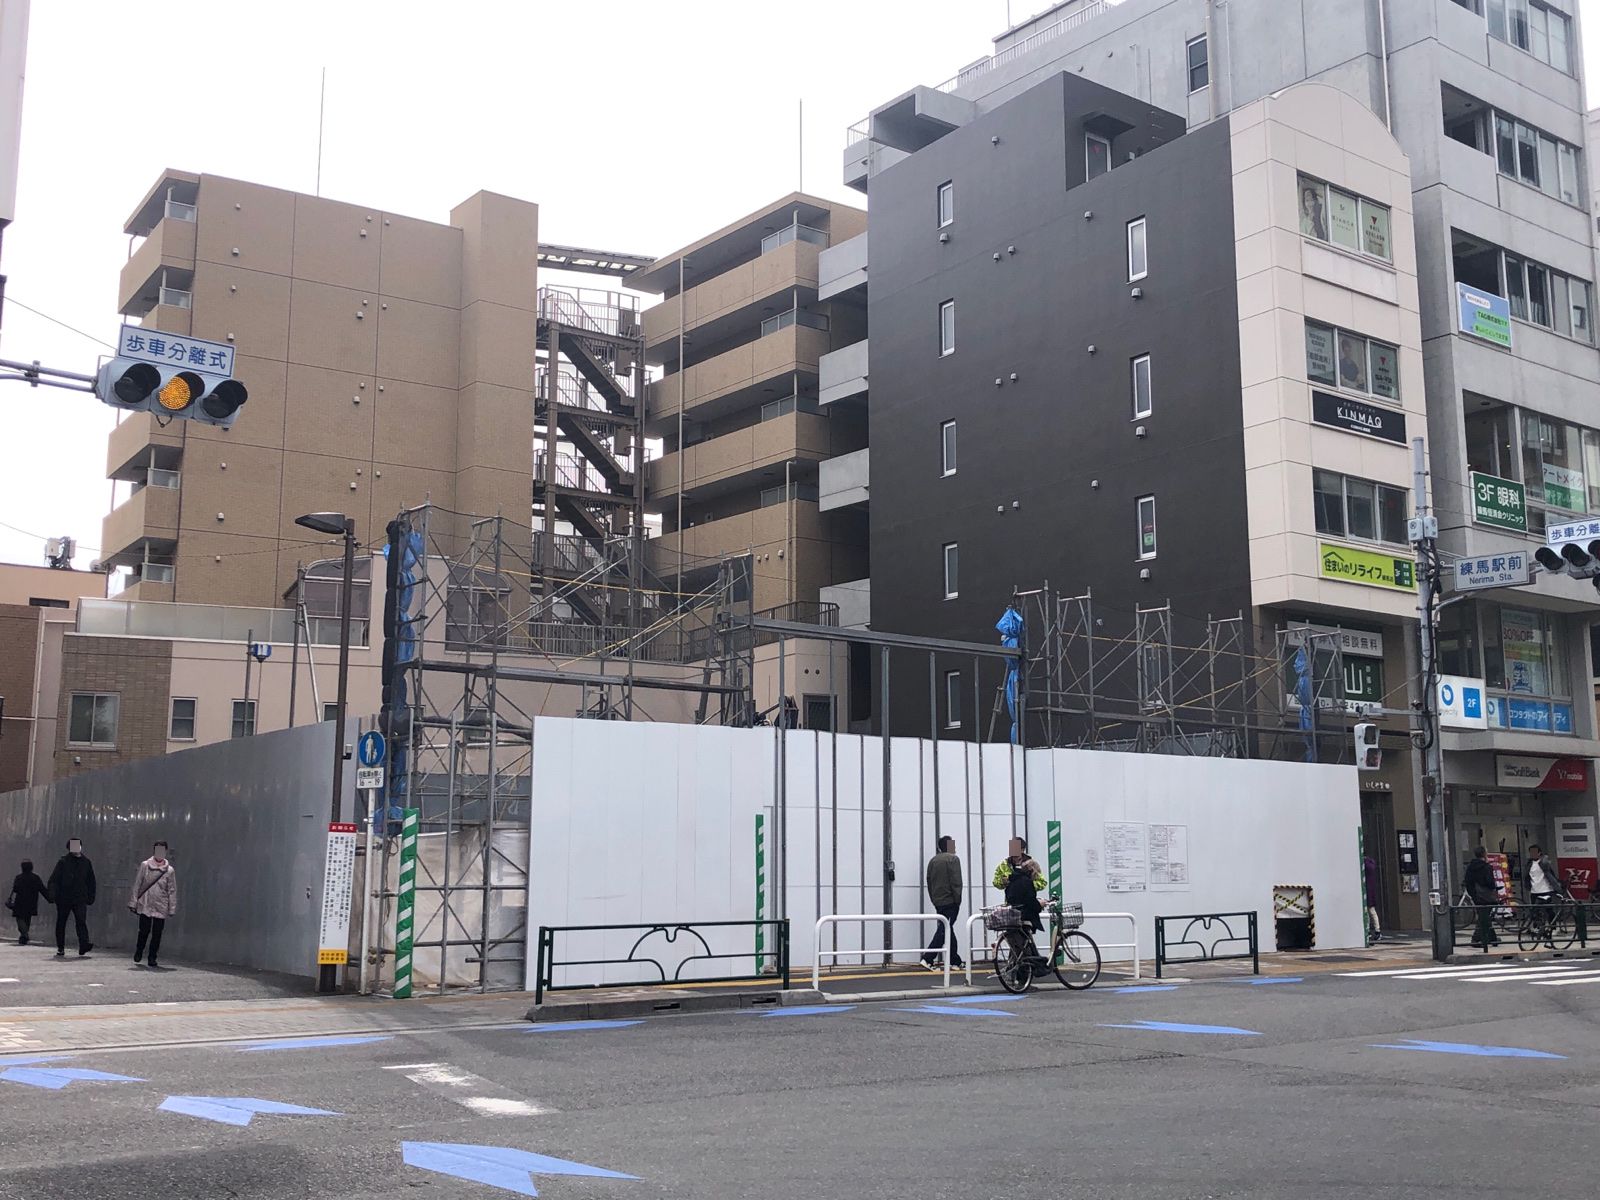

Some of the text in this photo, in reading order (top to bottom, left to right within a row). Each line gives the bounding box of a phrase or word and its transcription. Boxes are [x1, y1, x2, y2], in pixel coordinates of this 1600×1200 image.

[126, 335, 228, 370] 歩車分離式
[1337, 406, 1382, 427] KINMAQ
[1477, 482, 1495, 502] 3F
[1497, 486, 1521, 510] 眼科
[1324, 558, 1383, 579] 住まいのリライフ
[1460, 555, 1522, 576] 練馬駅前
[1469, 575, 1495, 585] Nerima
[1342, 634, 1378, 651] 相談無料
[1467, 697, 1477, 708] 2F
